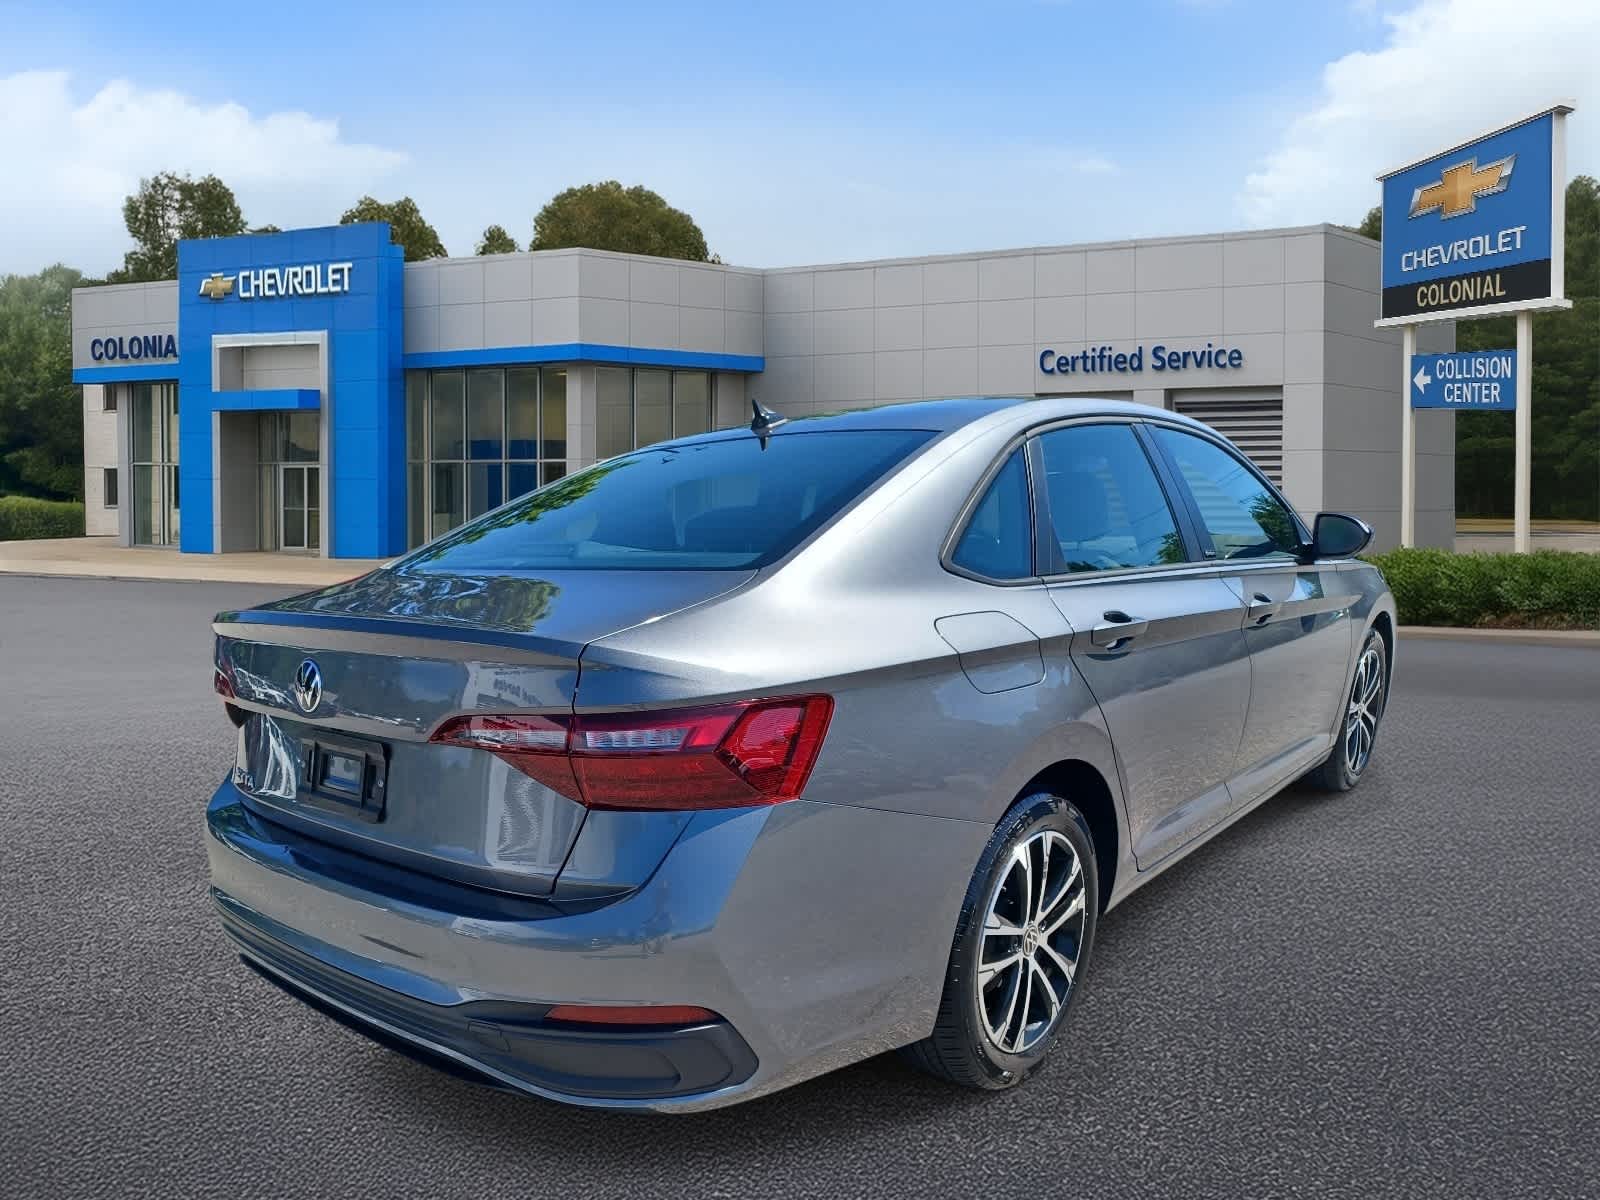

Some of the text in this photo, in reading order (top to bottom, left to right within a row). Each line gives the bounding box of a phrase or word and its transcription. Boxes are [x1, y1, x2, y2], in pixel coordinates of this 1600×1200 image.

[1401, 225, 1527, 272] CHEVROLET
[238, 262, 352, 298] CHEVROLET
[1416, 273, 1506, 307] COLONIAL
[91, 334, 178, 361] COLONIA
[1039, 343, 1243, 375] Certified Service
[1436, 356, 1512, 379] COLLISION
[1444, 382, 1500, 403] CENTER
